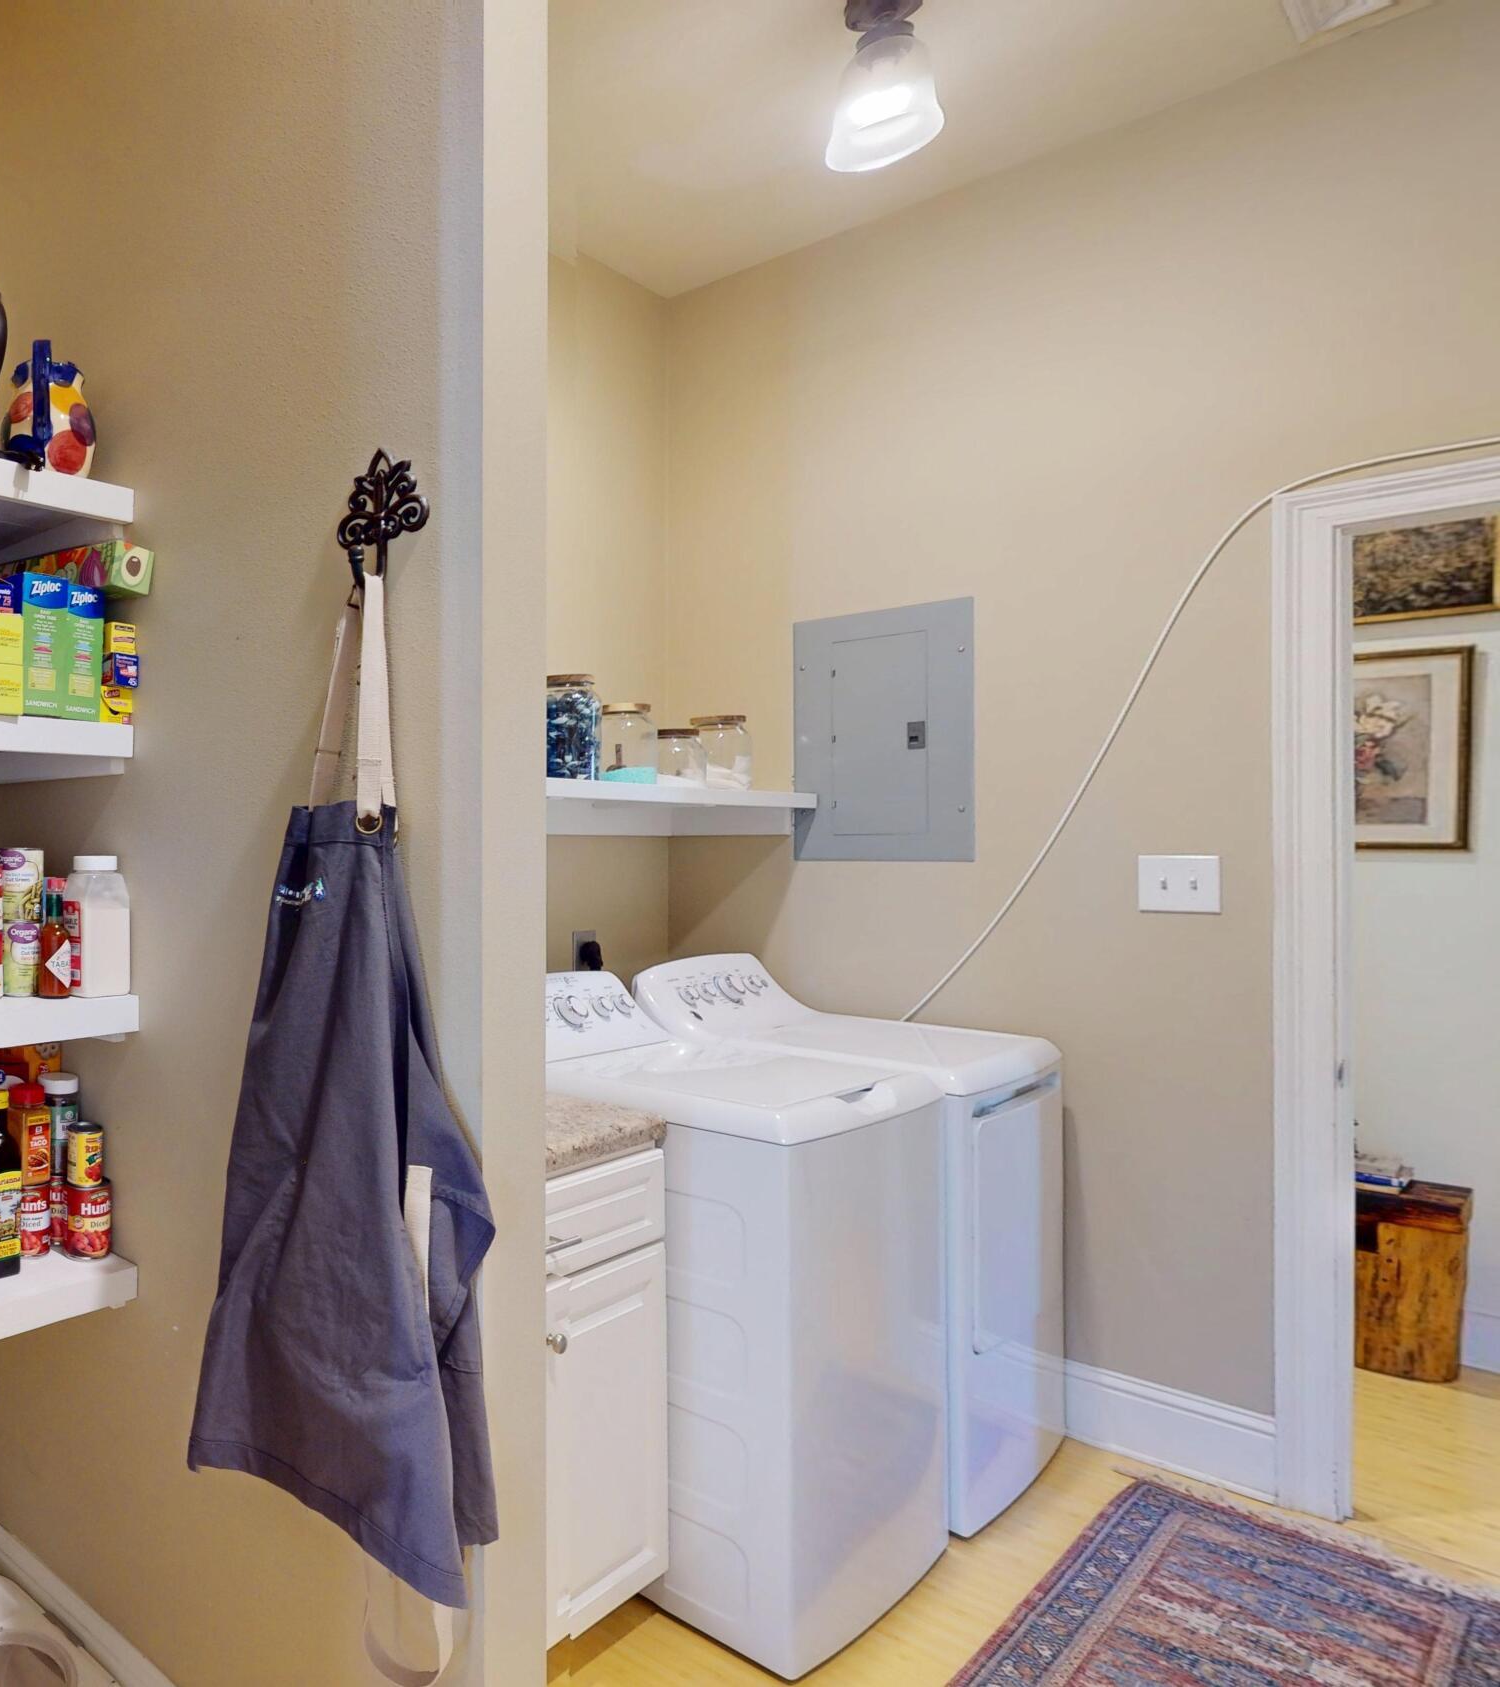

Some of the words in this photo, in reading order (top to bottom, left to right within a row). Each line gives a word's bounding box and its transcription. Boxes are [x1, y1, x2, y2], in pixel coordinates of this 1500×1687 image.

[31, 581, 62, 596] Ziploc
[71, 591, 98, 607] Ziploc
[25, 699, 58, 709] SANDWICH
[65, 705, 96, 714] SANDWICH
[10, 928, 37, 937] Organic
[30, 1138, 48, 1147] TACO
